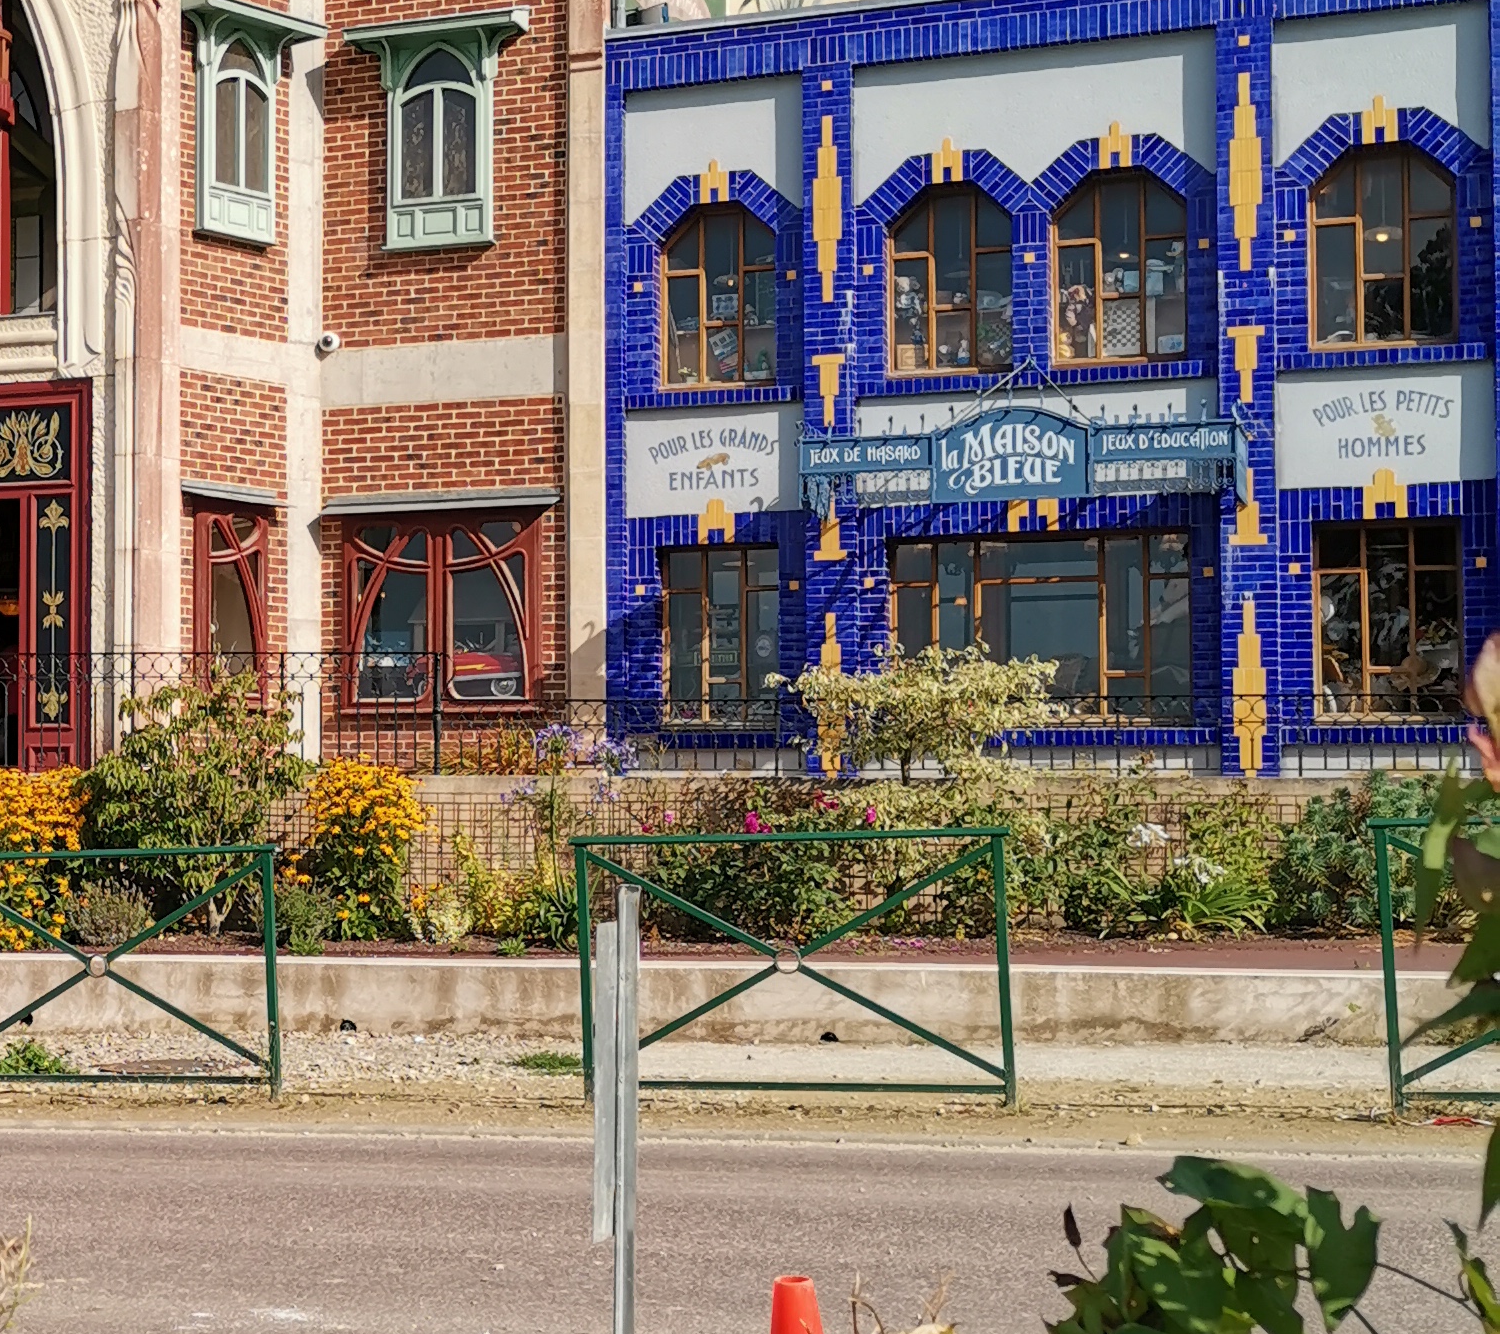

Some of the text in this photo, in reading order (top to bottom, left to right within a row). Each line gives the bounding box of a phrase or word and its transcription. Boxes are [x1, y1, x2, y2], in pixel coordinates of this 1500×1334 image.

[1311, 389, 1455, 427] POUR LES PETITS
[647, 425, 779, 465] POUR LES GRANDS
[809, 444, 921, 467] JEUX DE HASARD
[938, 422, 1076, 472] la MAISON
[1102, 432, 1136, 455] JEUX
[1337, 434, 1427, 459] HOMMES
[668, 467, 760, 491] ENFANTS
[963, 455, 1063, 496] BLEUE
